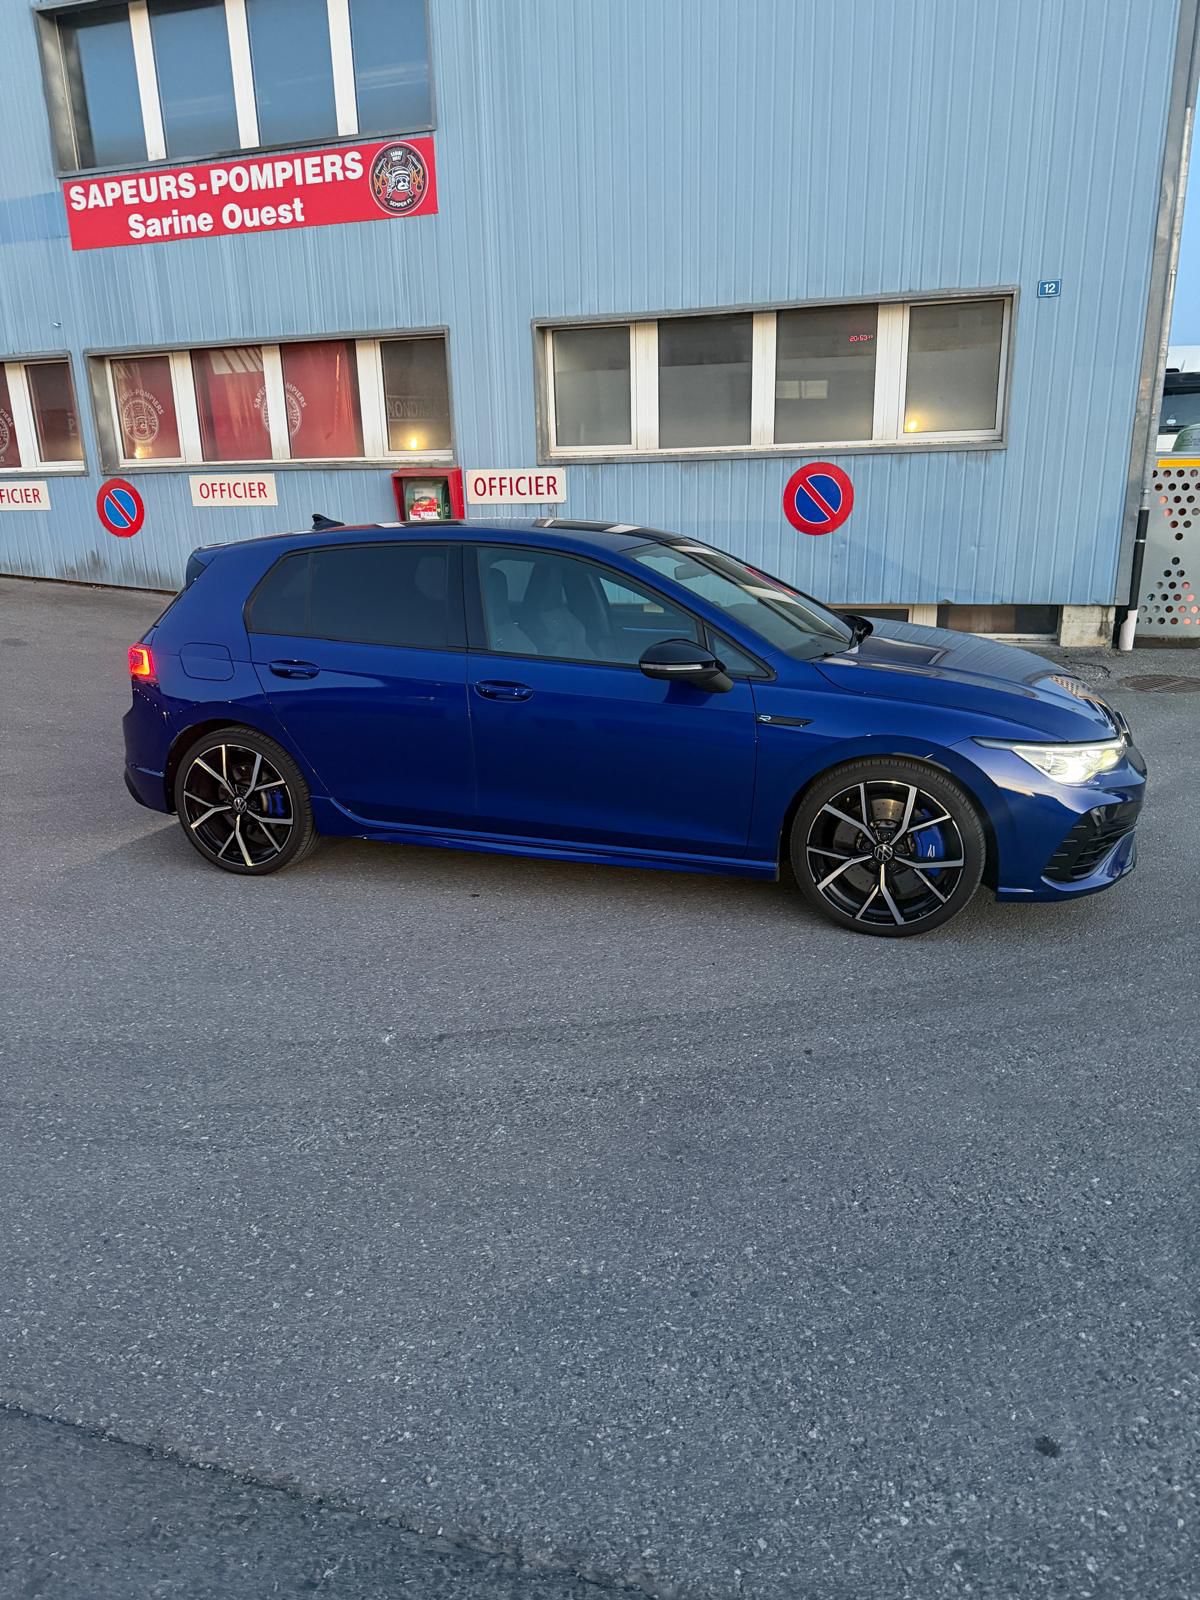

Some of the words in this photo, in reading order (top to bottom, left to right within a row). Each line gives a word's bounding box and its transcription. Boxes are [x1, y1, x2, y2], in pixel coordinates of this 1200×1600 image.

[128, 209, 214, 239] Sarine
[222, 198, 304, 230] Ouest
[1043, 282, 1056, 294] 12
[199, 482, 268, 499] OFFICIER
[474, 475, 558, 497] OFFICIER
